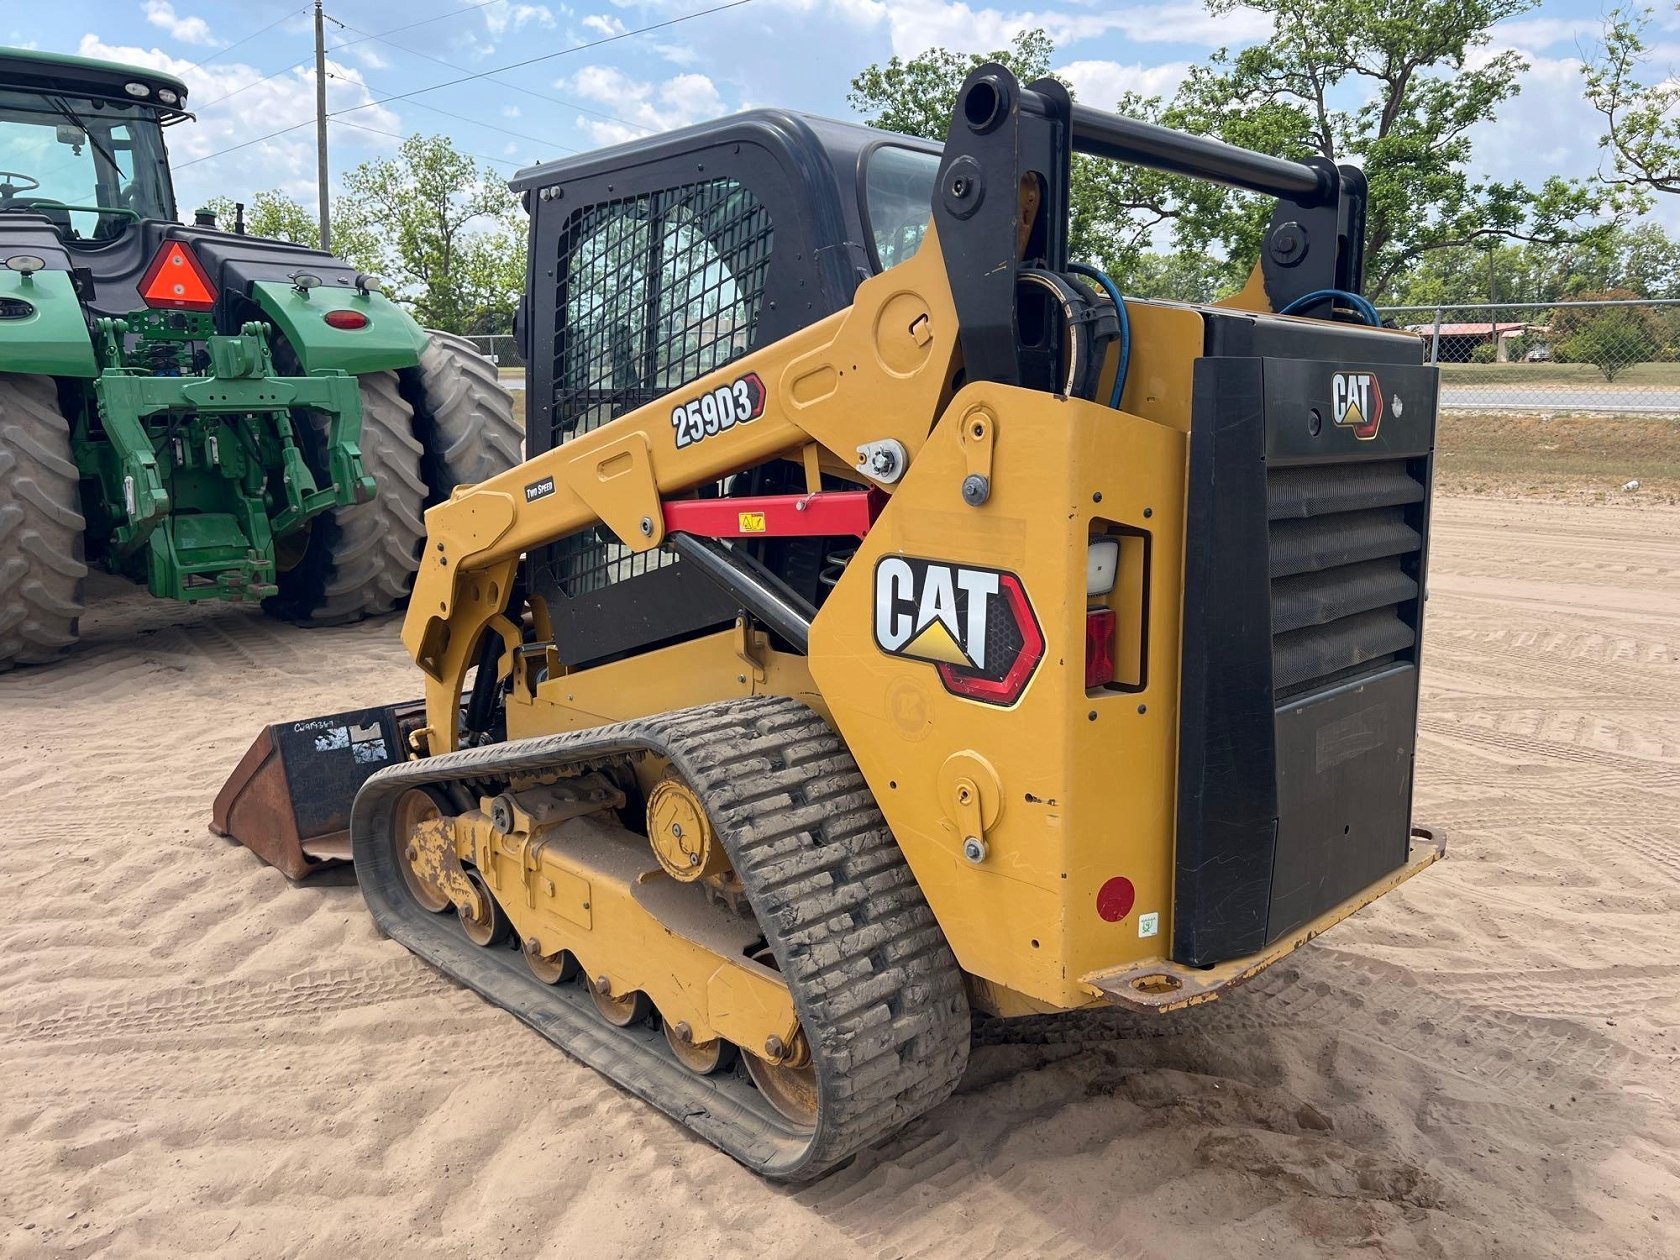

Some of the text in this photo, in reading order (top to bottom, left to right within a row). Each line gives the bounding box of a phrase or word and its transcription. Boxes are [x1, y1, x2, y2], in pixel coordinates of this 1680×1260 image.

[672, 379, 753, 448] 259D3
[1332, 373, 1371, 424] CAT
[876, 558, 999, 670] CAT
